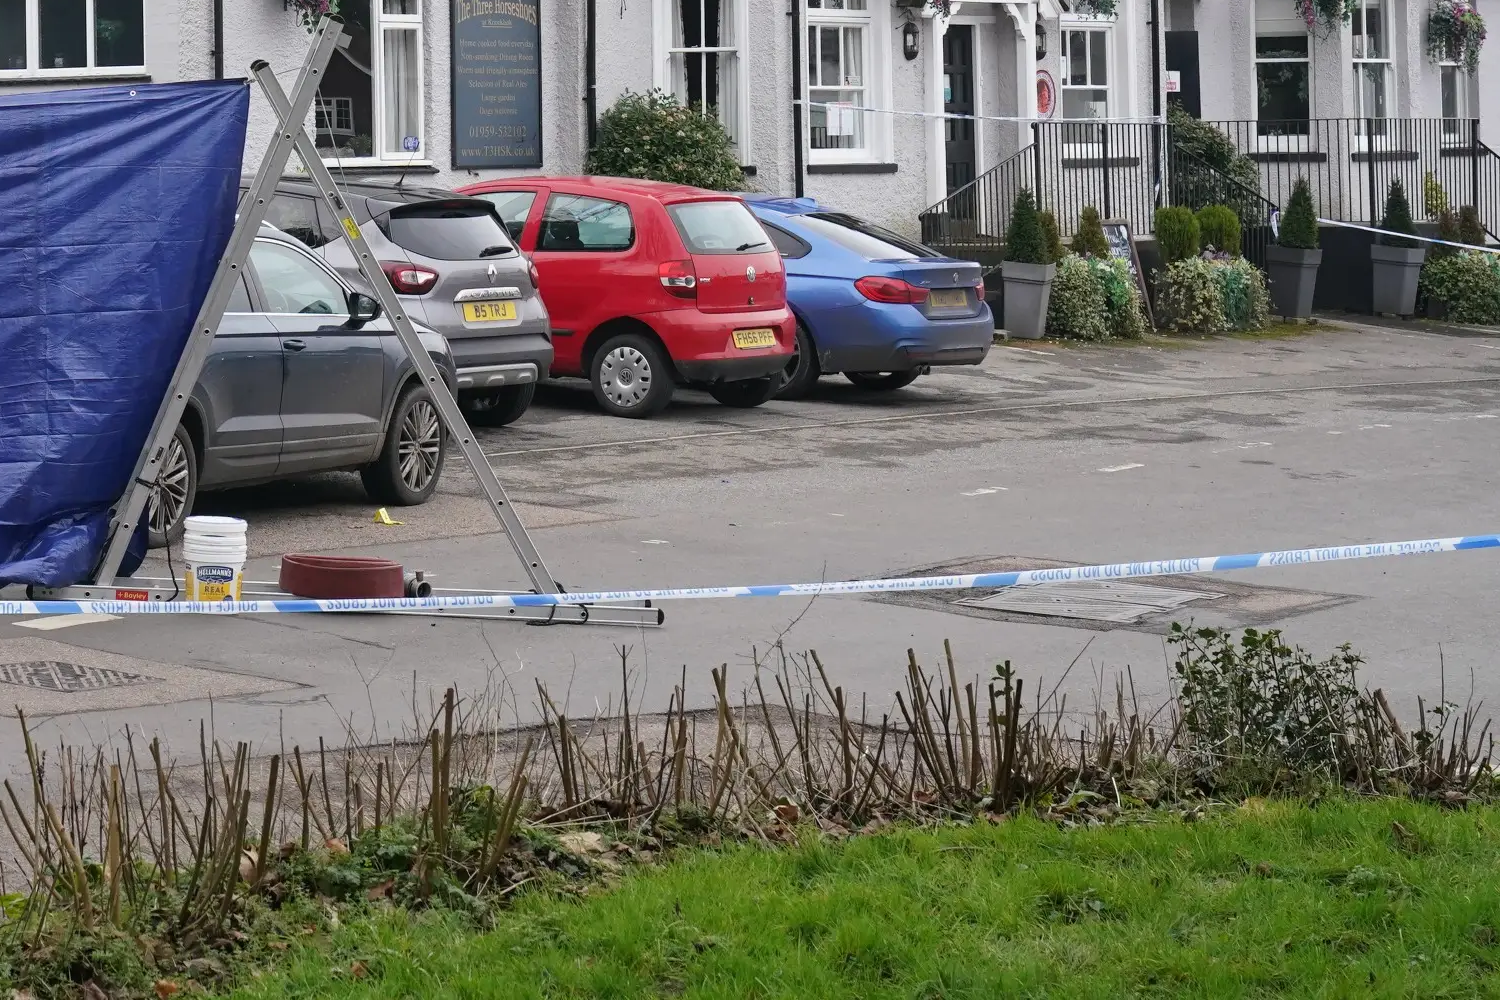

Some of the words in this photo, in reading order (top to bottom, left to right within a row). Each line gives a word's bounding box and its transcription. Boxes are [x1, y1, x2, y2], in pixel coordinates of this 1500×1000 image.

[498, 40, 510, 48] food
[488, 303, 507, 317] TRJ
[198, 568, 232, 578] HELLMANN'S
[204, 586, 226, 594] REAL
[124, 591, 147, 600] Bayley
